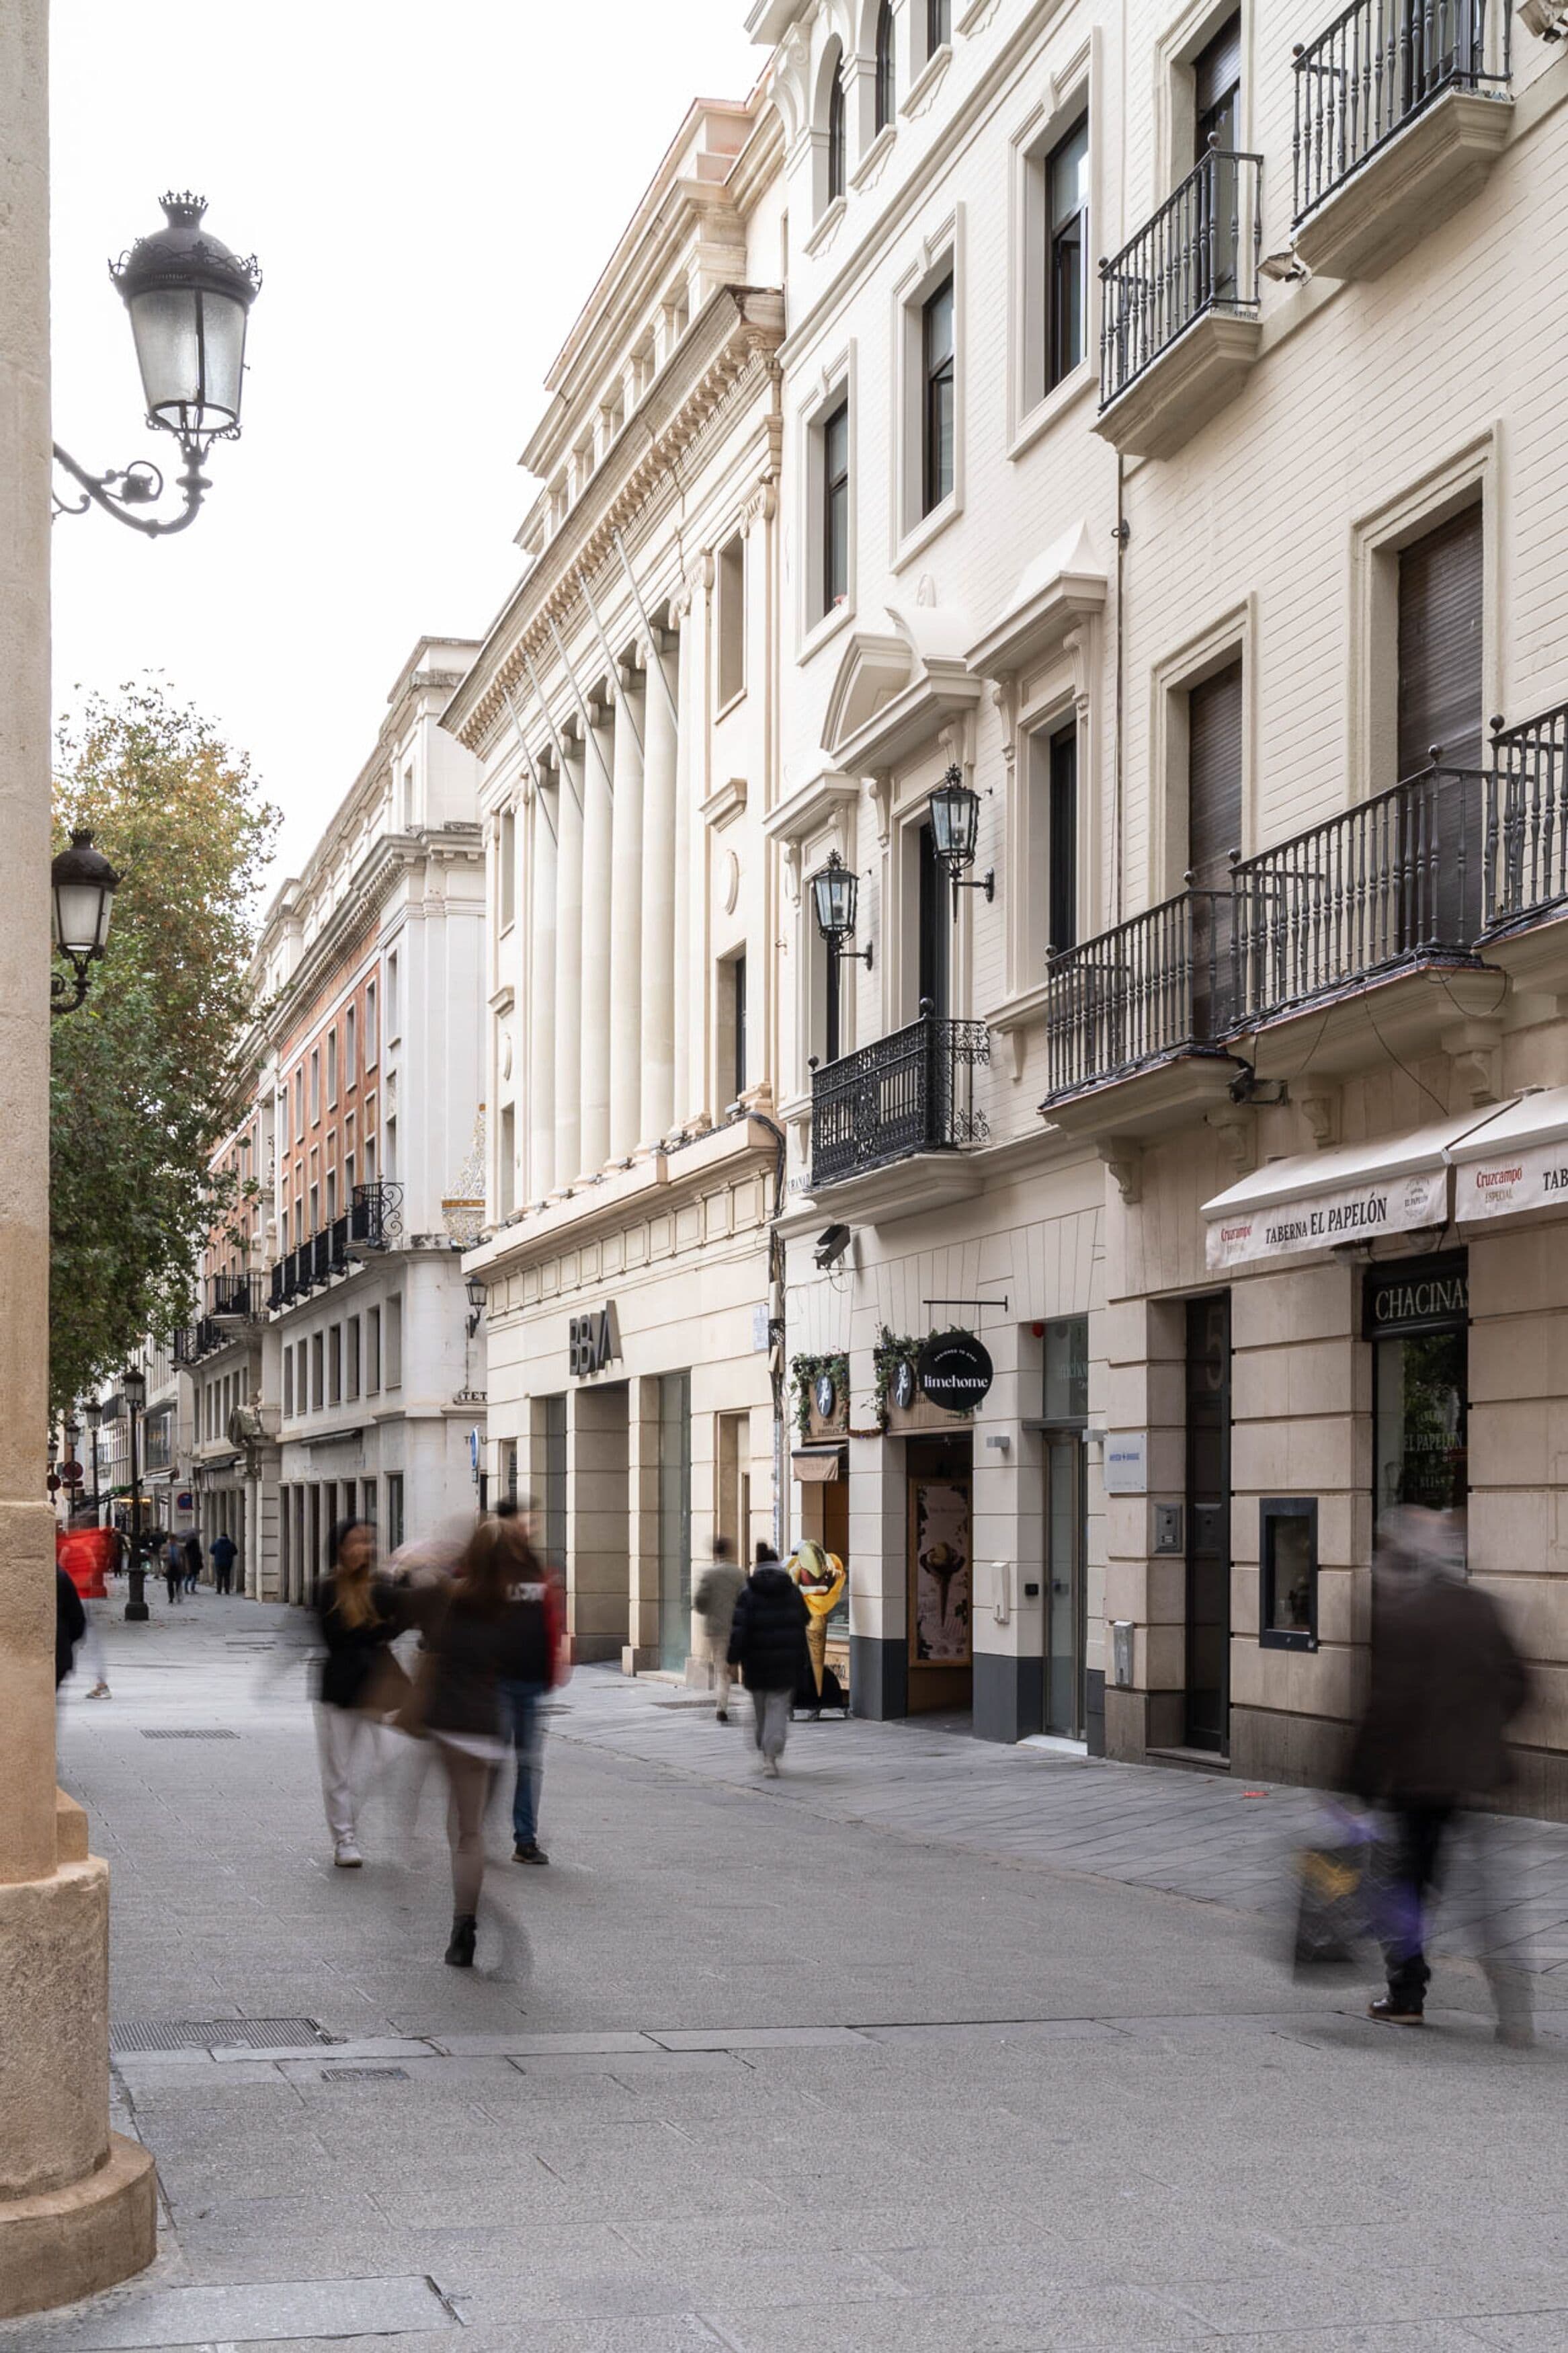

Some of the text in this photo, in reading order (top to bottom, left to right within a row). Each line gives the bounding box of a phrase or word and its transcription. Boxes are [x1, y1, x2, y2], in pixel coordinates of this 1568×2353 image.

[1476, 1167, 1523, 1189] Cruzcampo
[1543, 1168, 1568, 1191] TAB
[1266, 1192, 1389, 1244] TABERNA EL PAPELÓN
[1375, 1277, 1469, 1321] CHACINA
[569, 1300, 624, 1376] BBVA
[924, 1374, 989, 1388] limehome
